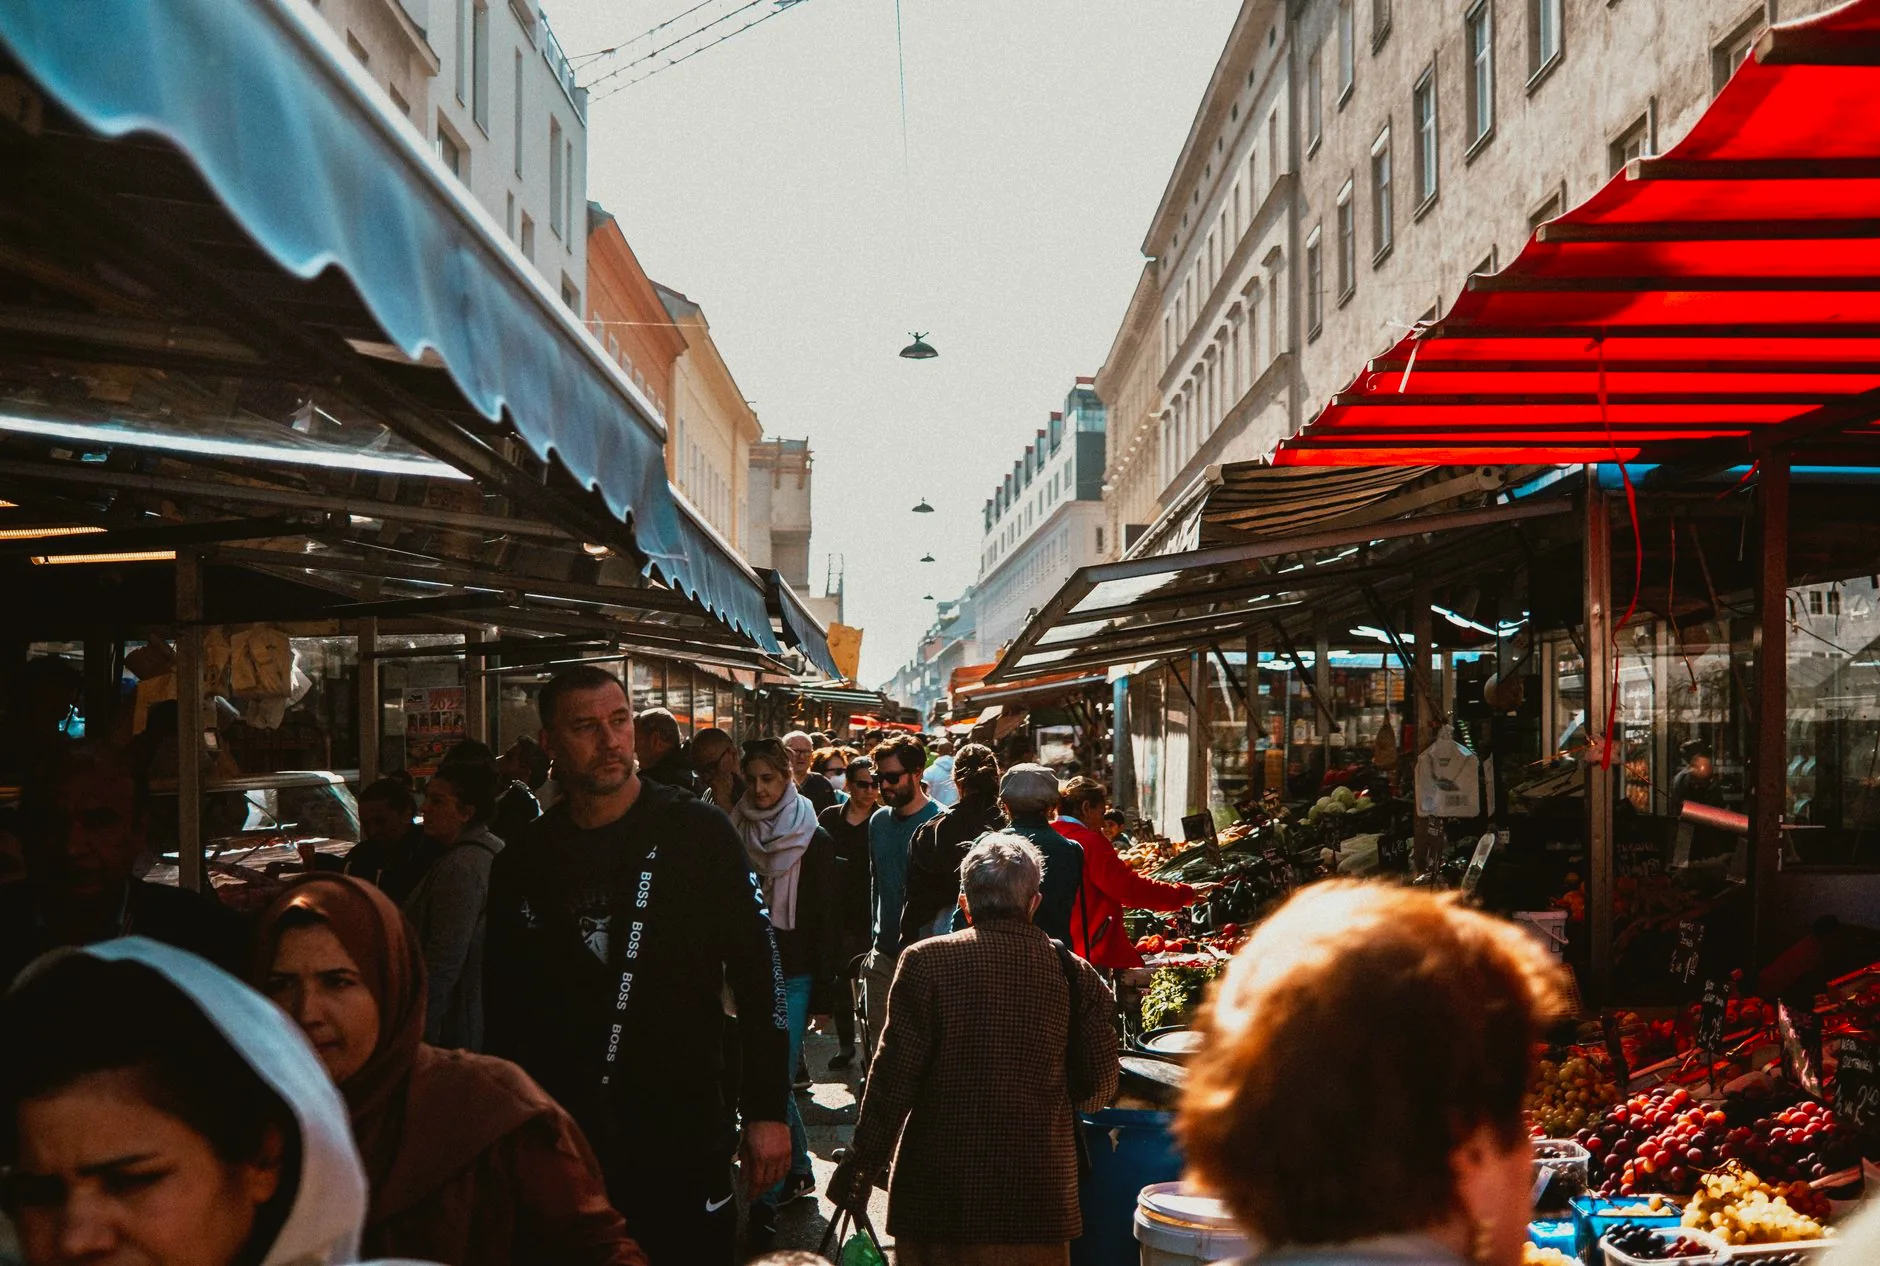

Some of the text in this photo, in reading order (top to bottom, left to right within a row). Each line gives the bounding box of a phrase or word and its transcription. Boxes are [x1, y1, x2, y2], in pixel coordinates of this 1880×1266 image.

[430, 698, 465, 710] 2022
[636, 871, 652, 909] BOSS
[626, 921, 643, 960] BOSS
[616, 972, 633, 1011] BOSS
[606, 1024, 622, 1062] BOSS
